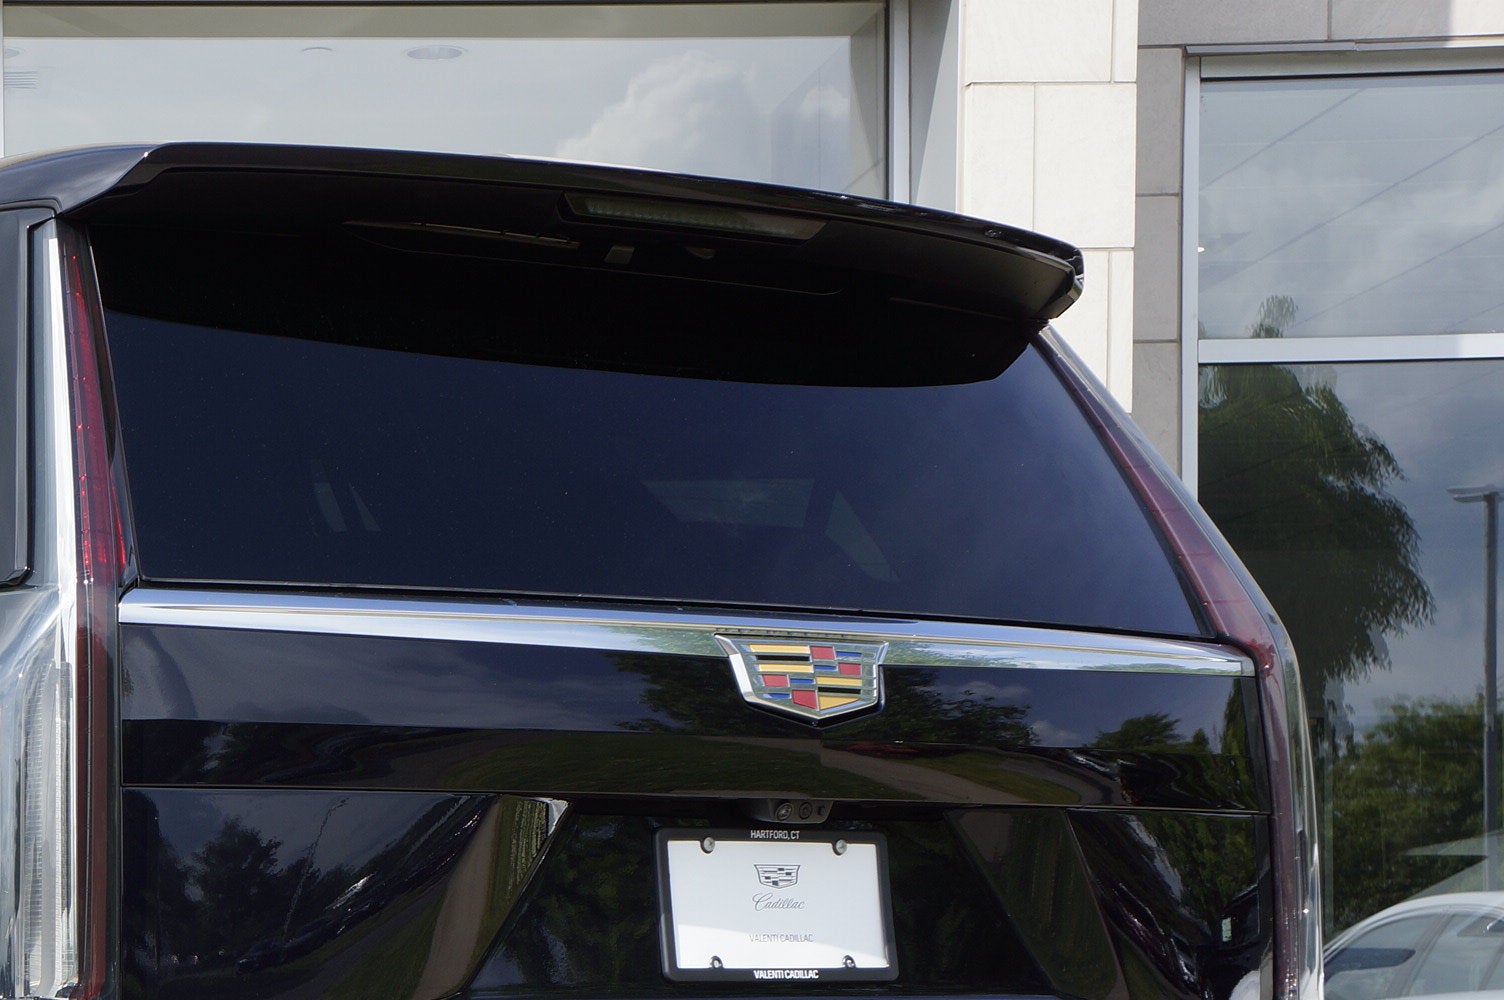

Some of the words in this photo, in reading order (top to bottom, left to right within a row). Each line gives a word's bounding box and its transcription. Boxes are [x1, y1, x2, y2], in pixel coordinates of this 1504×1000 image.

[751, 830, 790, 840] HARTFORD,
[791, 831, 800, 839] CT
[752, 892, 806, 911] Cadillac
[780, 934, 814, 943] CADILLAC
[753, 969, 784, 979] VALENTI
[785, 969, 819, 979] CADILLAC
